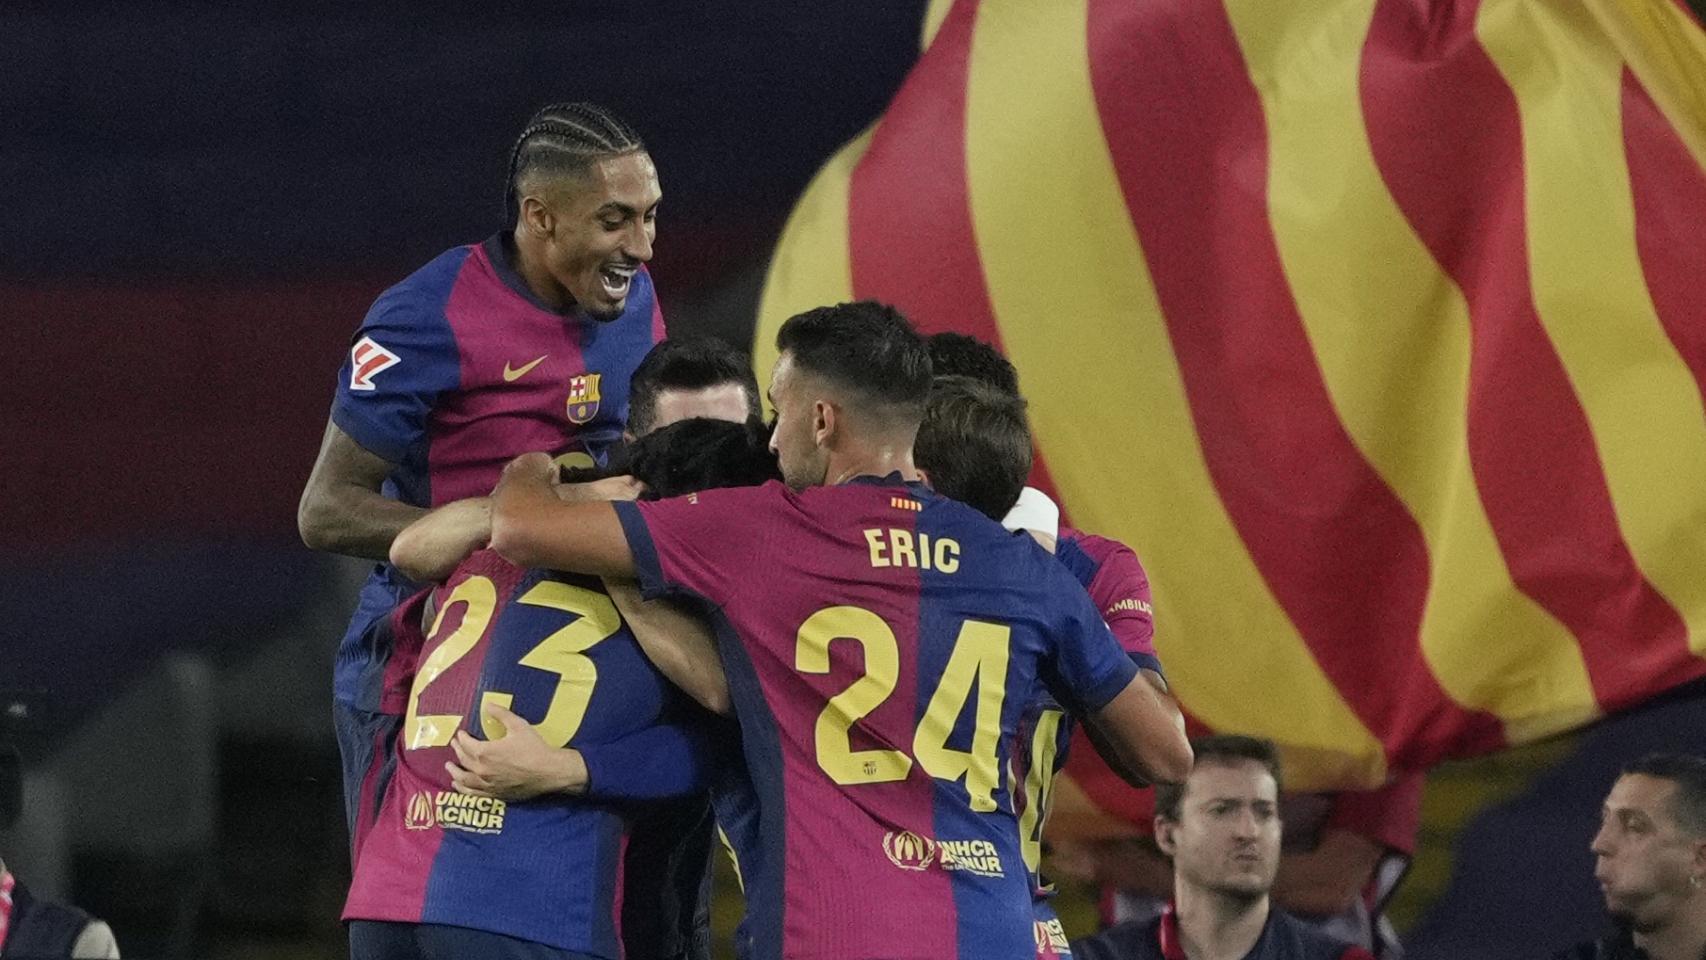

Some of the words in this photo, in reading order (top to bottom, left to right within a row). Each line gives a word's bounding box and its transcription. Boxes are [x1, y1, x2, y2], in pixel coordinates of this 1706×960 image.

[863, 528, 960, 574] ERIC
[404, 575, 622, 750] 23
[795, 605, 1011, 813] 24
[435, 791, 506, 816] UNHCR
[435, 806, 504, 829] ACNUR
[936, 840, 998, 857] NHCR
